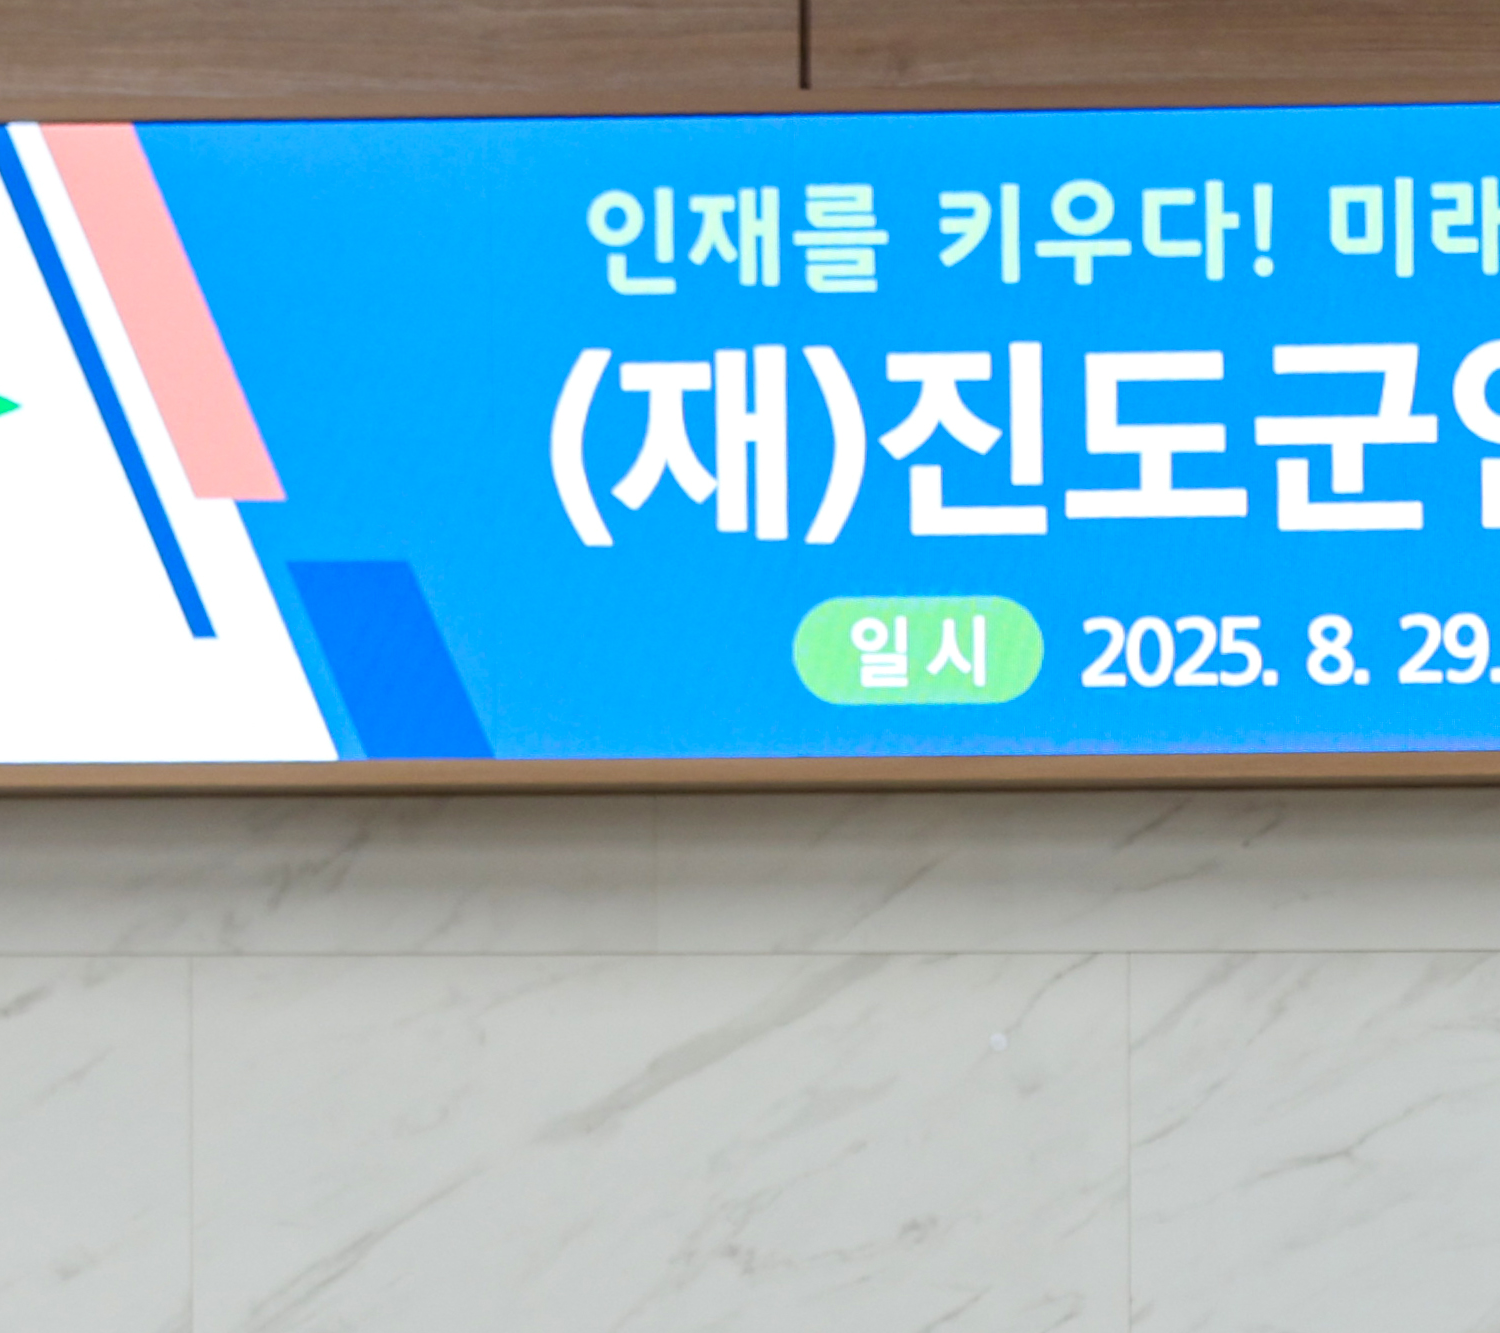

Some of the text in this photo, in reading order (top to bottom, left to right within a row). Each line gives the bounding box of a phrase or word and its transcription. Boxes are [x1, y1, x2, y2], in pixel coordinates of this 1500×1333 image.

[586, 184, 889, 295] 인재를
[938, 178, 1275, 285] 키우다!
[1080, 614, 1280, 688] 2025.
[1306, 612, 1371, 687] 8.
